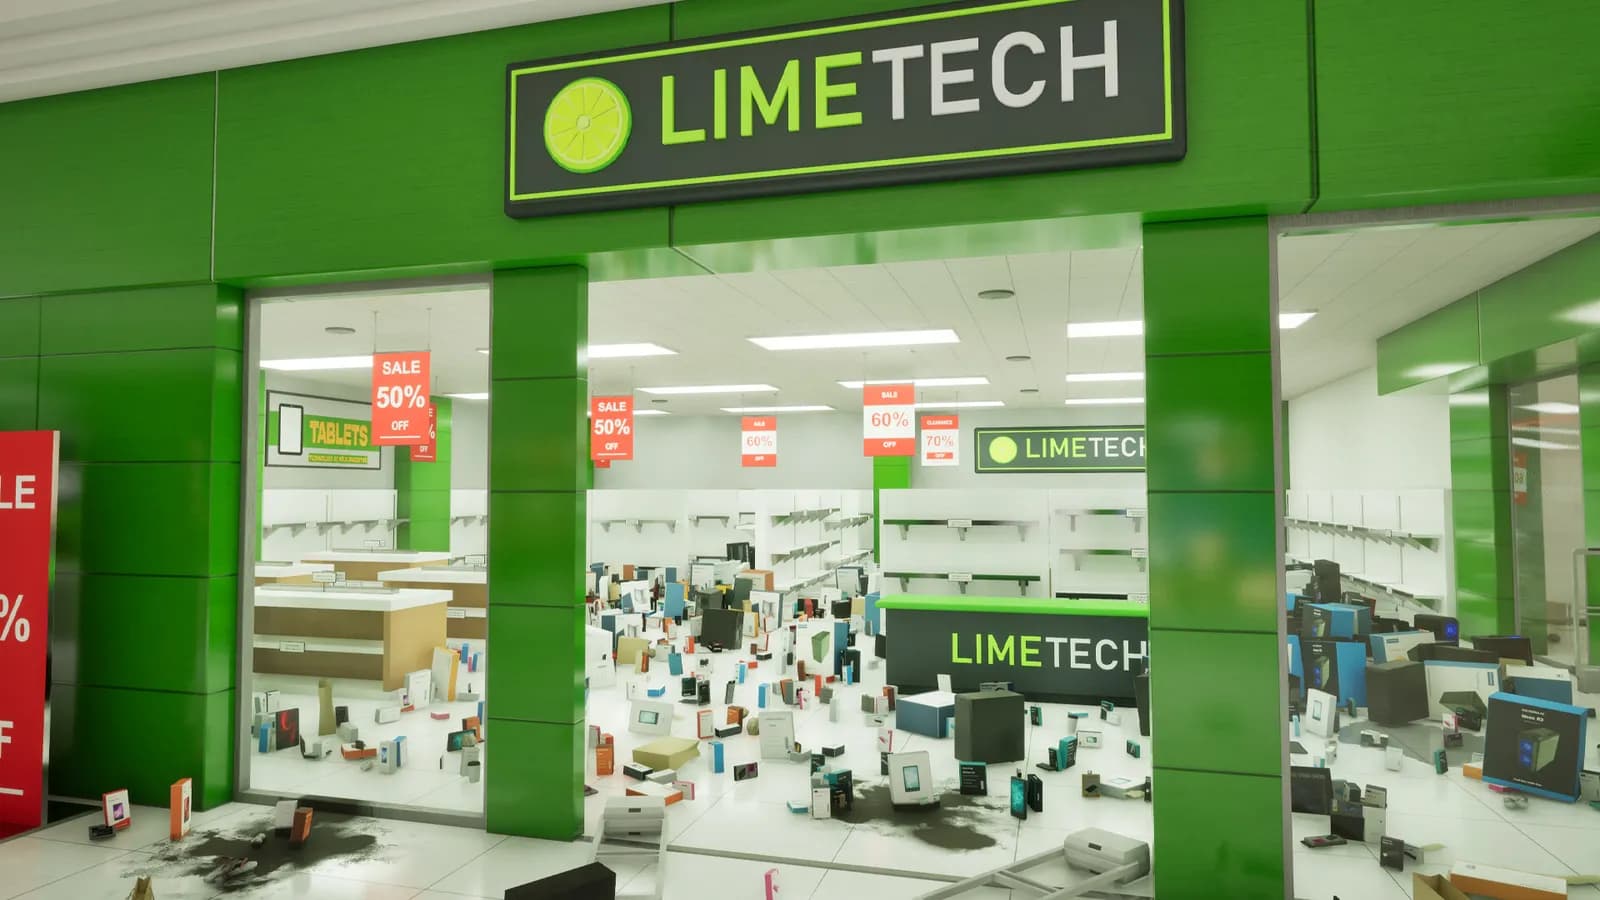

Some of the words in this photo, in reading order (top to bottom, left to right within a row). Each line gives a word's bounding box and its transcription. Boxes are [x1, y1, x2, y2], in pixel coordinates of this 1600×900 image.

[661, 19, 1119, 145] LIMETECH
[382, 360, 421, 375] SALE
[377, 384, 425, 409] 50%
[598, 401, 627, 412] SALE
[391, 420, 409, 431] OFF
[594, 418, 631, 435] 50%
[871, 411, 909, 427] 60%
[308, 420, 368, 447] TABLETS
[746, 435, 773, 447] 60%
[926, 435, 954, 447] 70%
[605, 442, 618, 451] OFF
[882, 441, 897, 449] OFF
[952, 632, 1147, 672] LIMETECH
